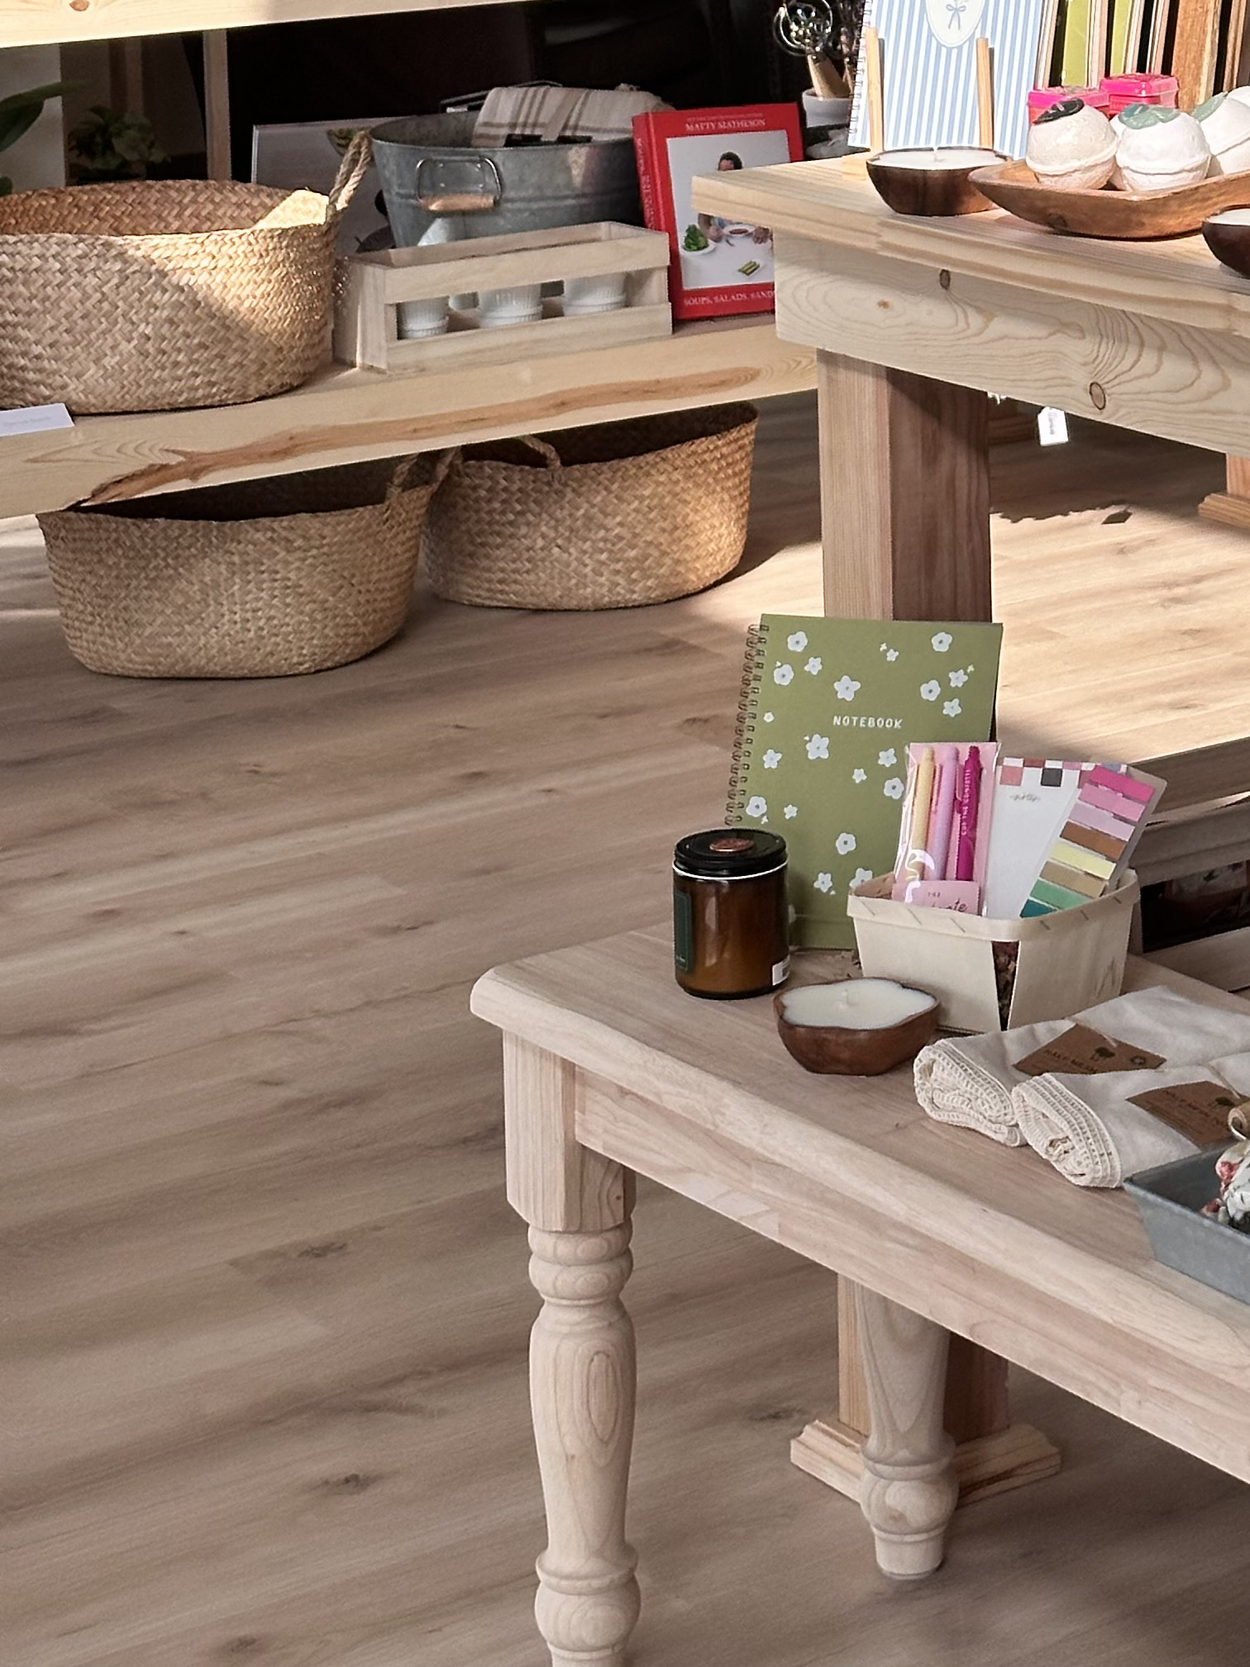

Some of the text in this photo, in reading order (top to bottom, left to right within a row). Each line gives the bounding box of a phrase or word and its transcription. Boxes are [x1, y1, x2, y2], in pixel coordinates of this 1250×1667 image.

[685, 122, 715, 132] MATTY
[684, 290, 775, 307] SOUPS, SALADS, SAND
[833, 715, 903, 730] NOTEBOOK
